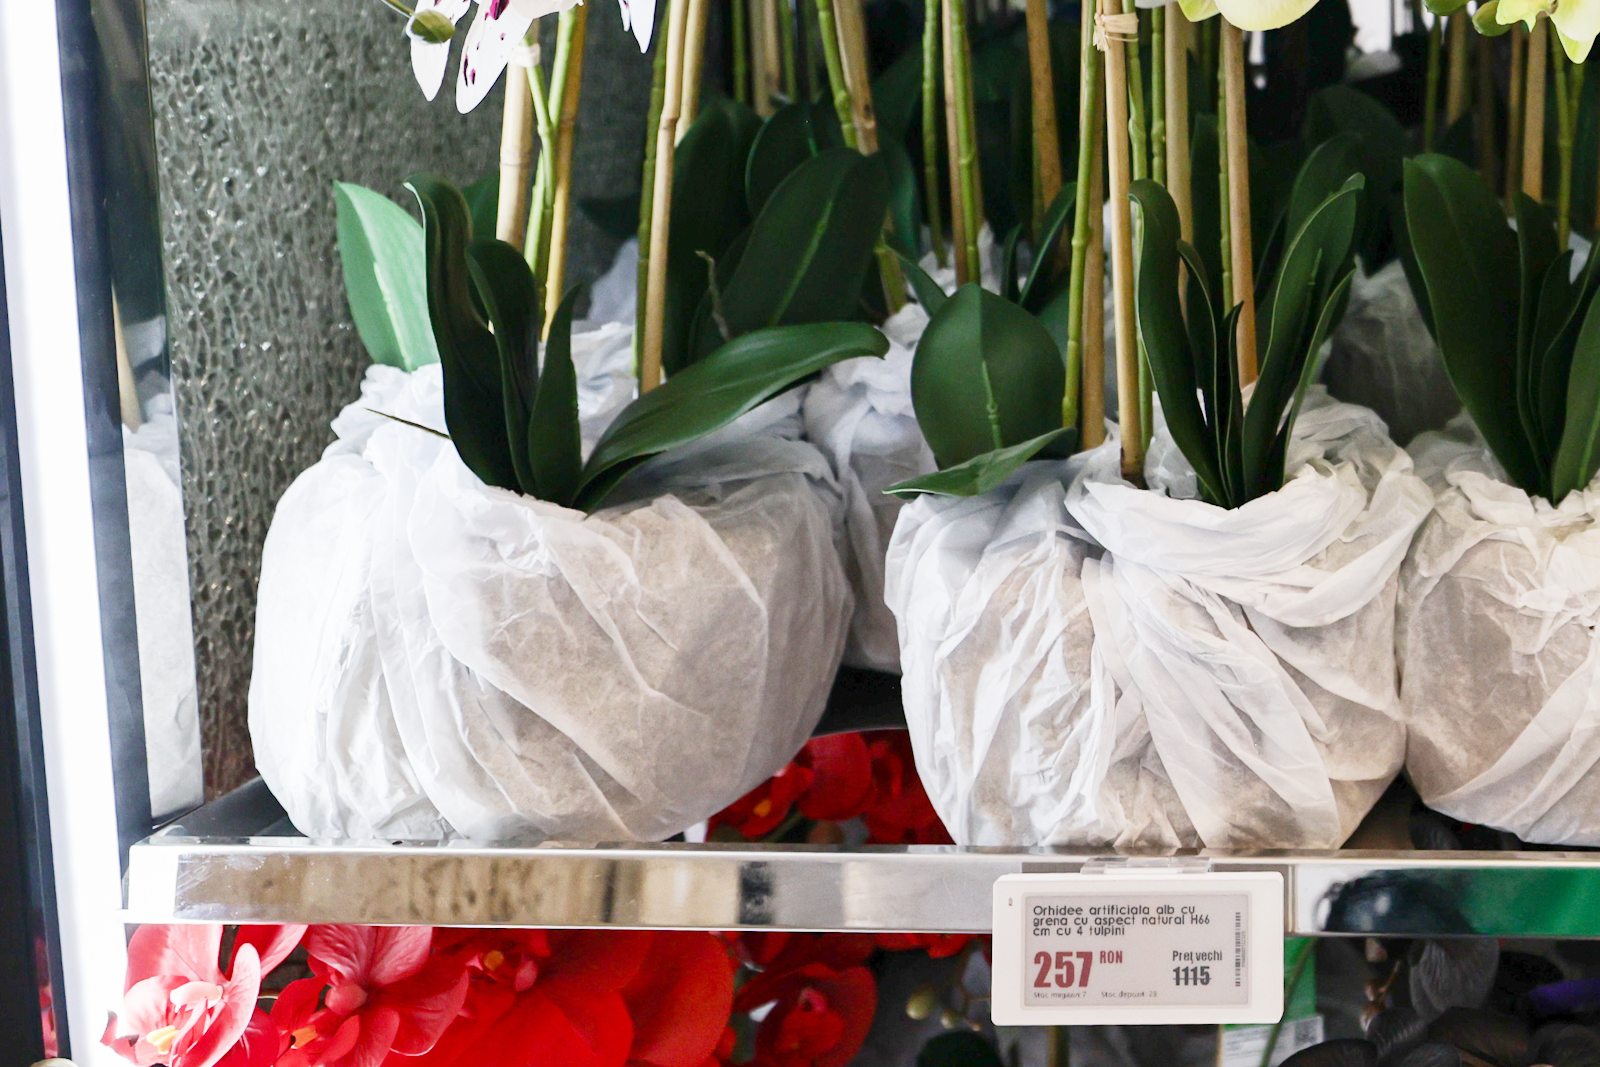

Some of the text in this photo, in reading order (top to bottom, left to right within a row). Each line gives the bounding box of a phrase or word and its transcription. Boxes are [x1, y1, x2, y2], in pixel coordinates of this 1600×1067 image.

[1033, 905, 1195, 915] Orhidee artificiala alb cu
[1033, 914, 1211, 927] grena cu aspect natural H66
[1033, 925, 1126, 937] cm cu 4 tulpini
[1195, 949, 1223, 961] vechi
[1033, 950, 1123, 988] 257 RON
[1172, 966, 1212, 986] 1115
